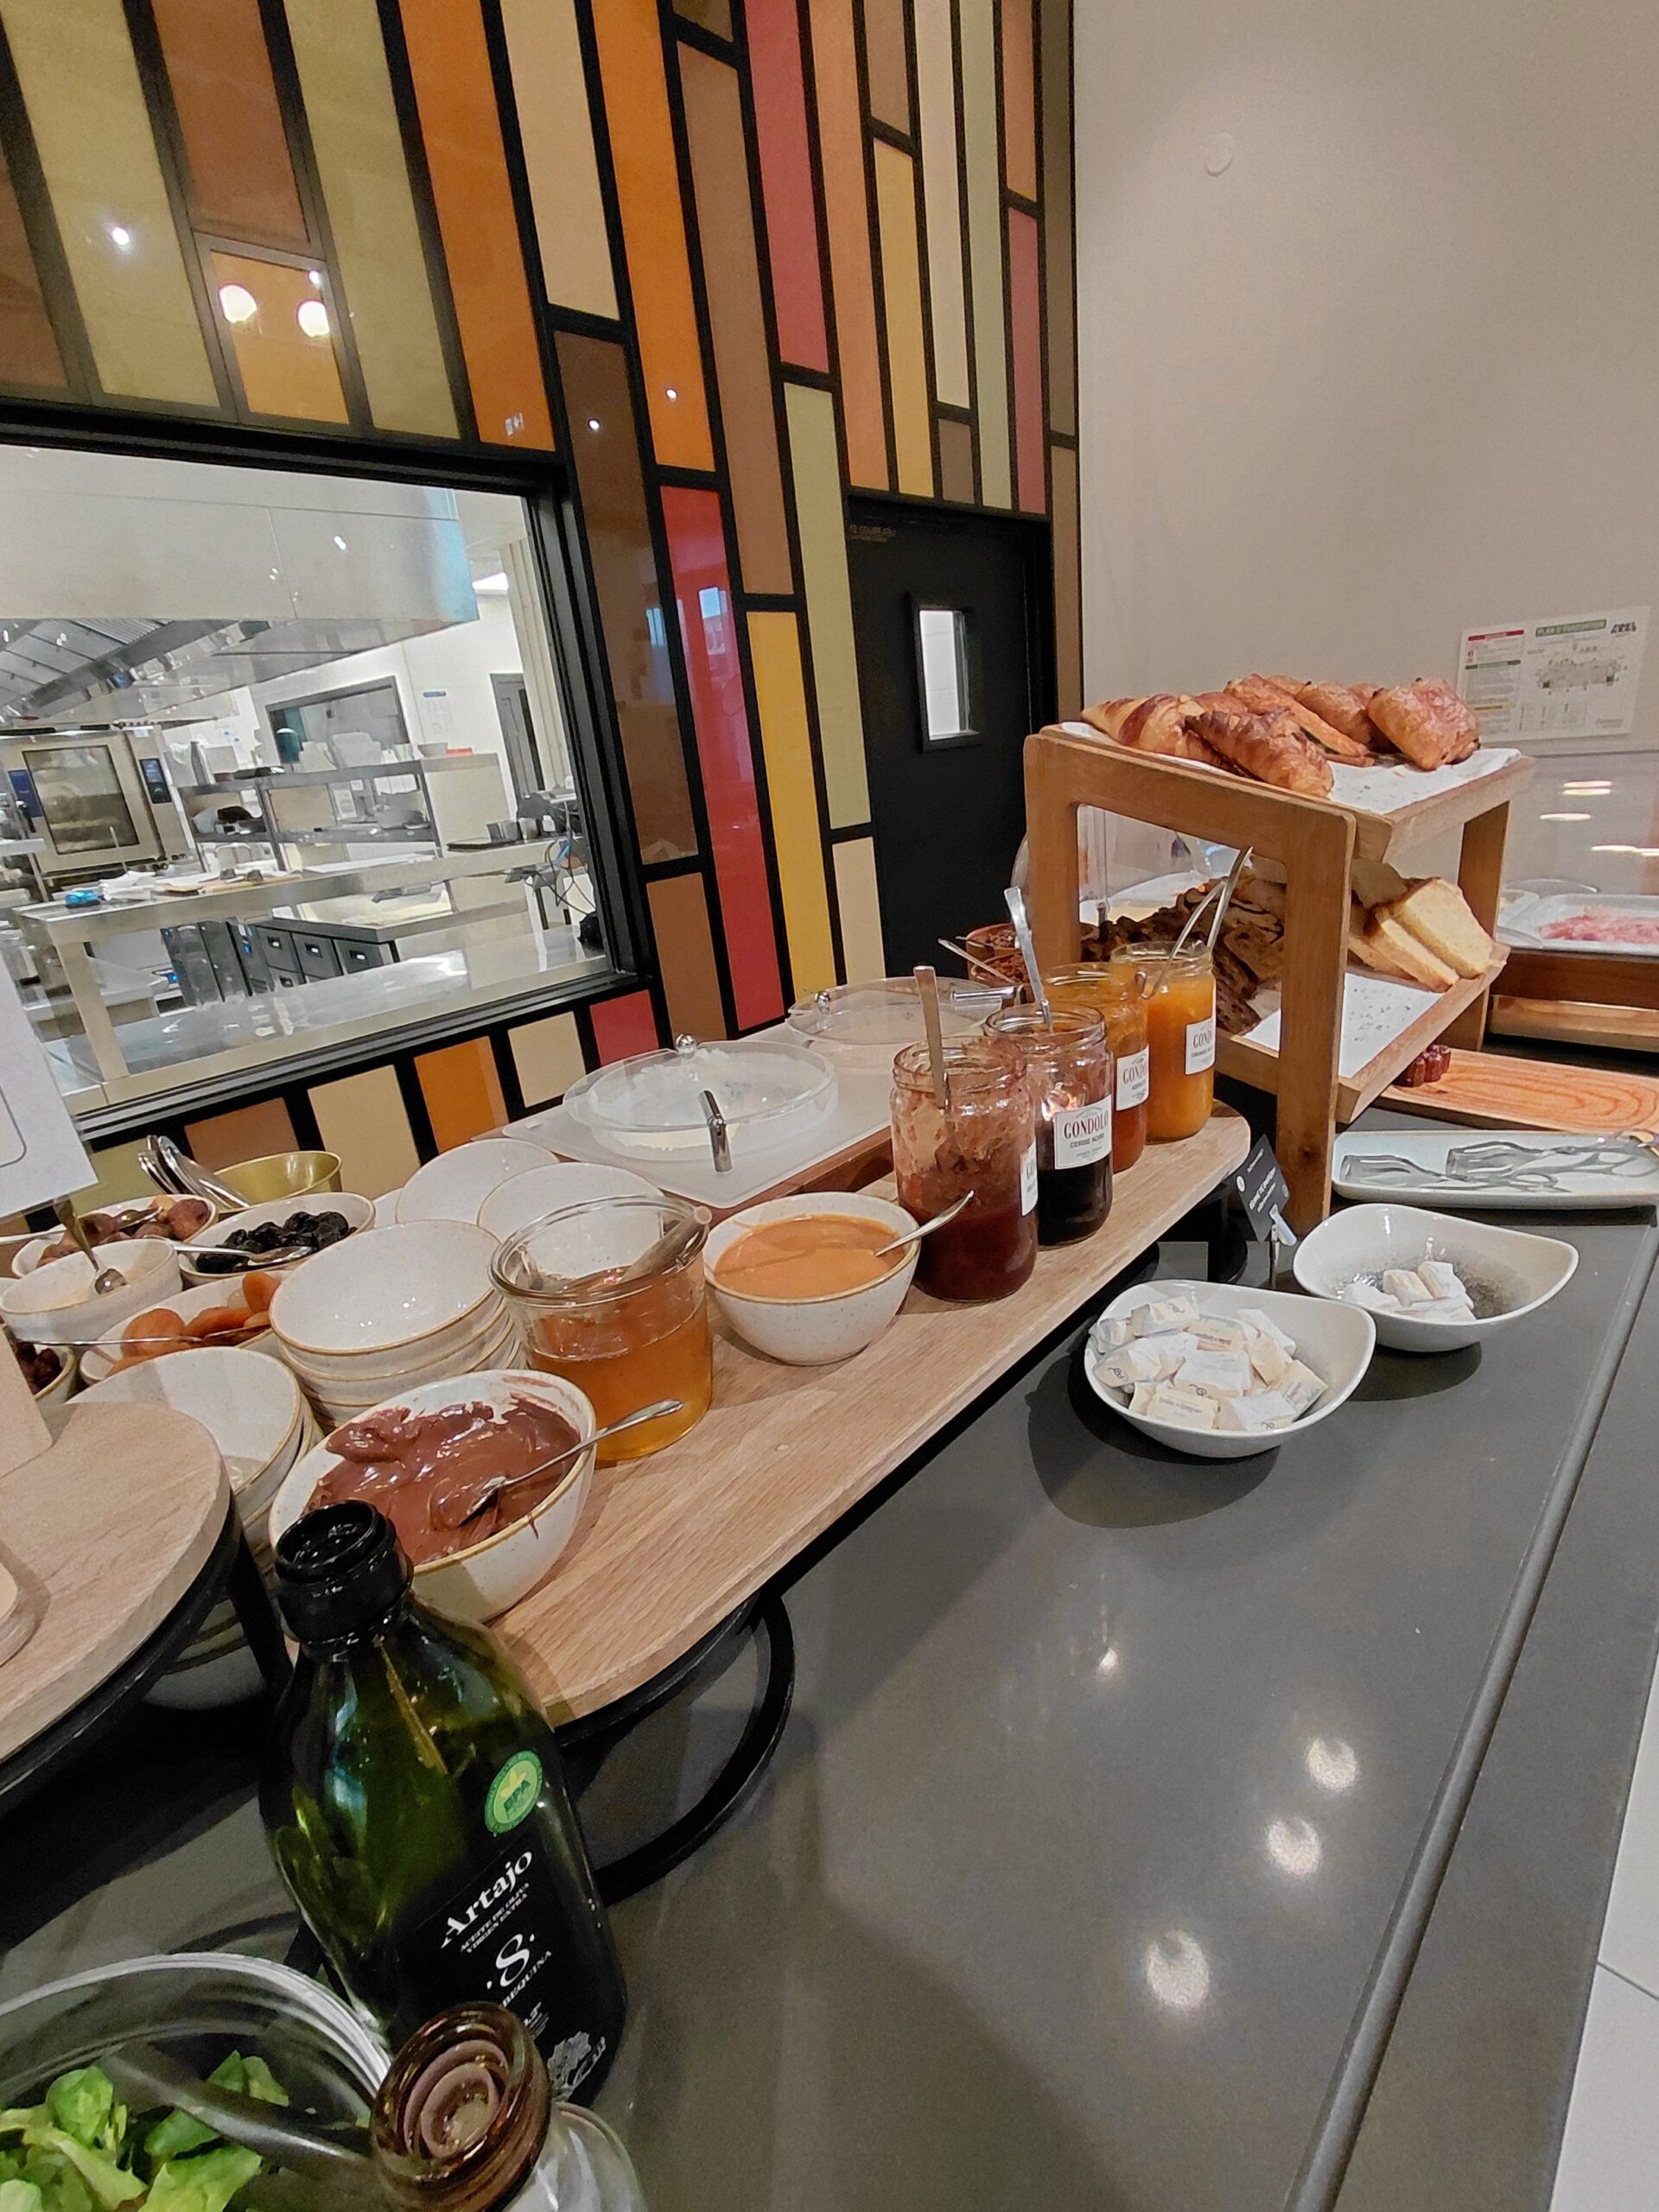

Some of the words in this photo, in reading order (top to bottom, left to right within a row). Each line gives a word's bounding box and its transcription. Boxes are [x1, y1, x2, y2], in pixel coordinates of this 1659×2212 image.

[1192, 1030, 1212, 1049] GOND
[1122, 1061, 1147, 1085] GONDO
[440, 1851, 533, 1949] Artajo
[501, 1949, 552, 2009] BEQUINA
